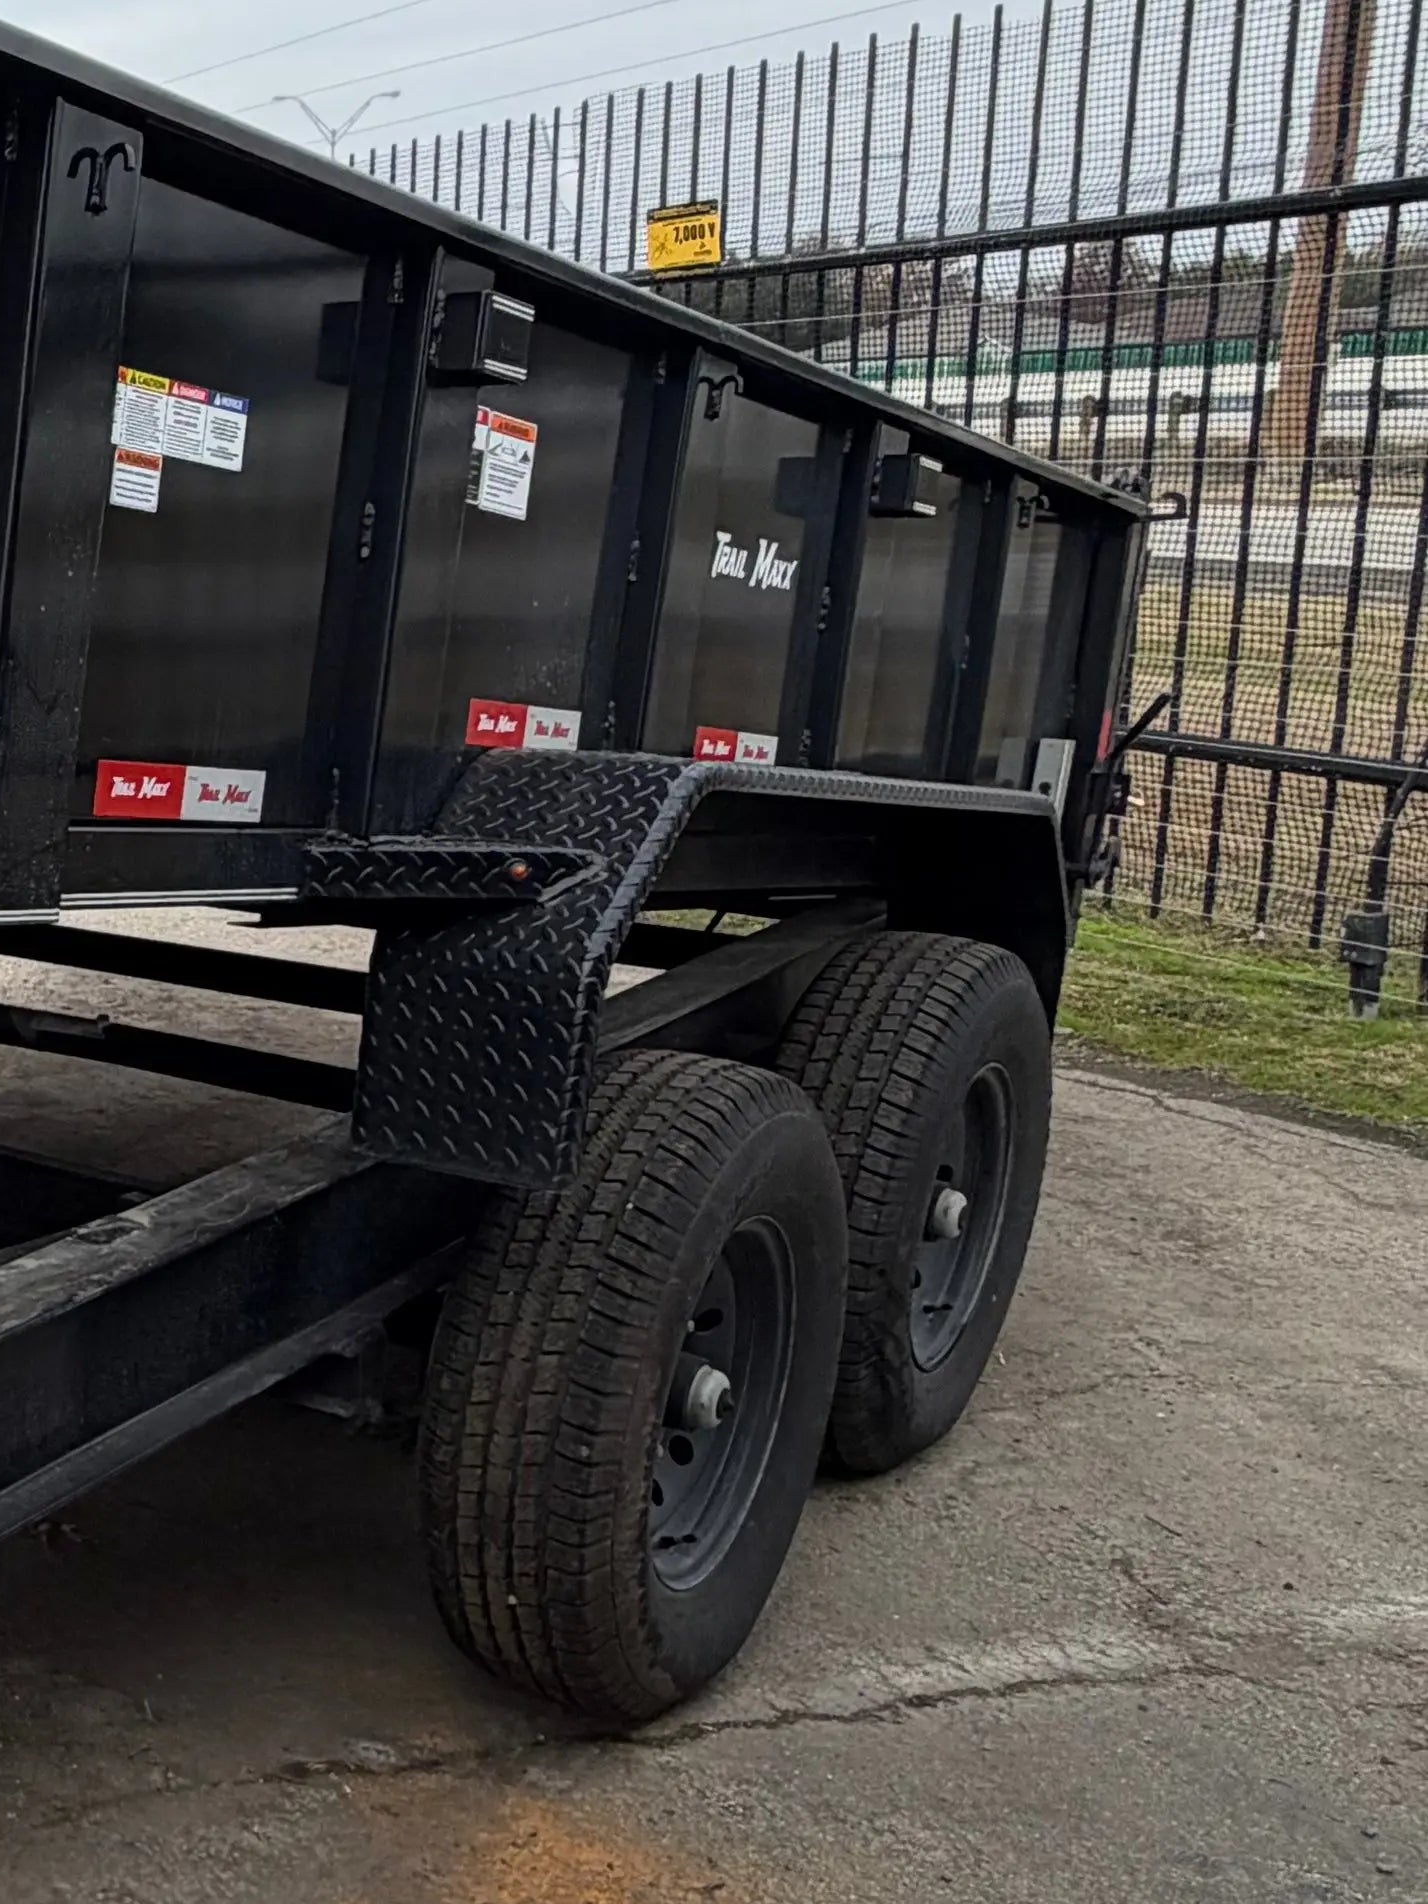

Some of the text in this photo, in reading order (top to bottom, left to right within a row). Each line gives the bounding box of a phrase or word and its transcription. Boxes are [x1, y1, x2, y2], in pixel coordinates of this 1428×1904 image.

[673, 224, 705, 244] 7,000
[708, 222, 715, 238] V
[712, 531, 798, 590] TRAIL MAXX
